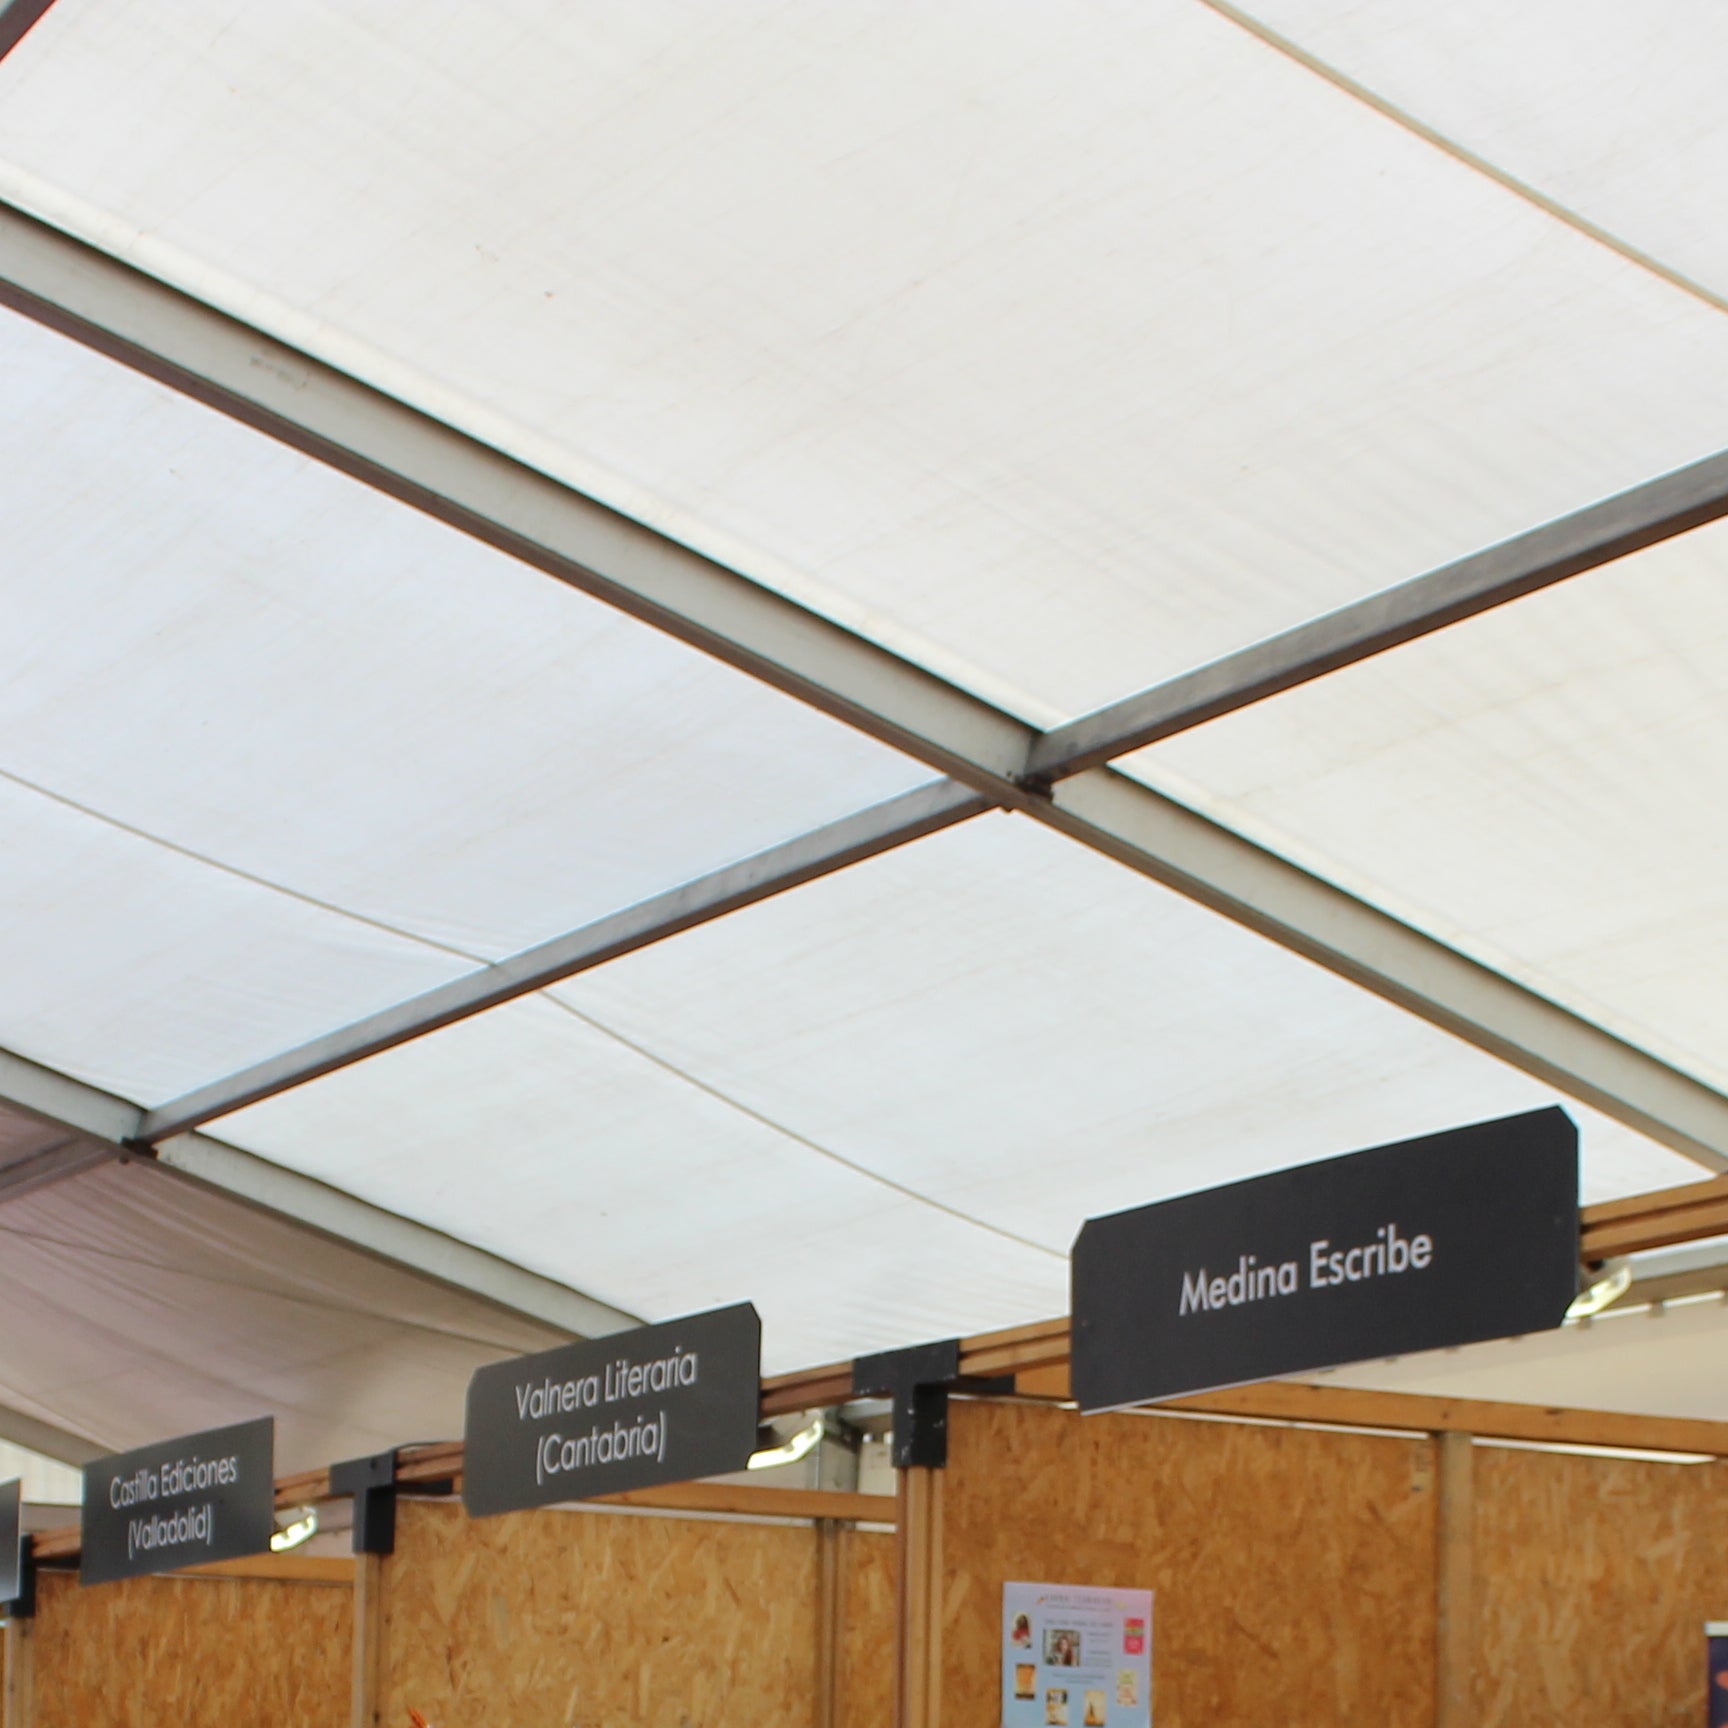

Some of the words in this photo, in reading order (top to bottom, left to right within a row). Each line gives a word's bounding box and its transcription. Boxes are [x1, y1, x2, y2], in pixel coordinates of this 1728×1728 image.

[1178, 1254, 1299, 1318] Medina
[1308, 1222, 1434, 1290] Escribe
[515, 1374, 600, 1421] Valnera
[604, 1345, 699, 1403] Literaria
[109, 1469, 159, 1511] Castilla
[160, 1455, 238, 1498] Ediciones
[535, 1410, 667, 1487] (Cantabria)
[127, 1503, 213, 1561] (Valladolid)
